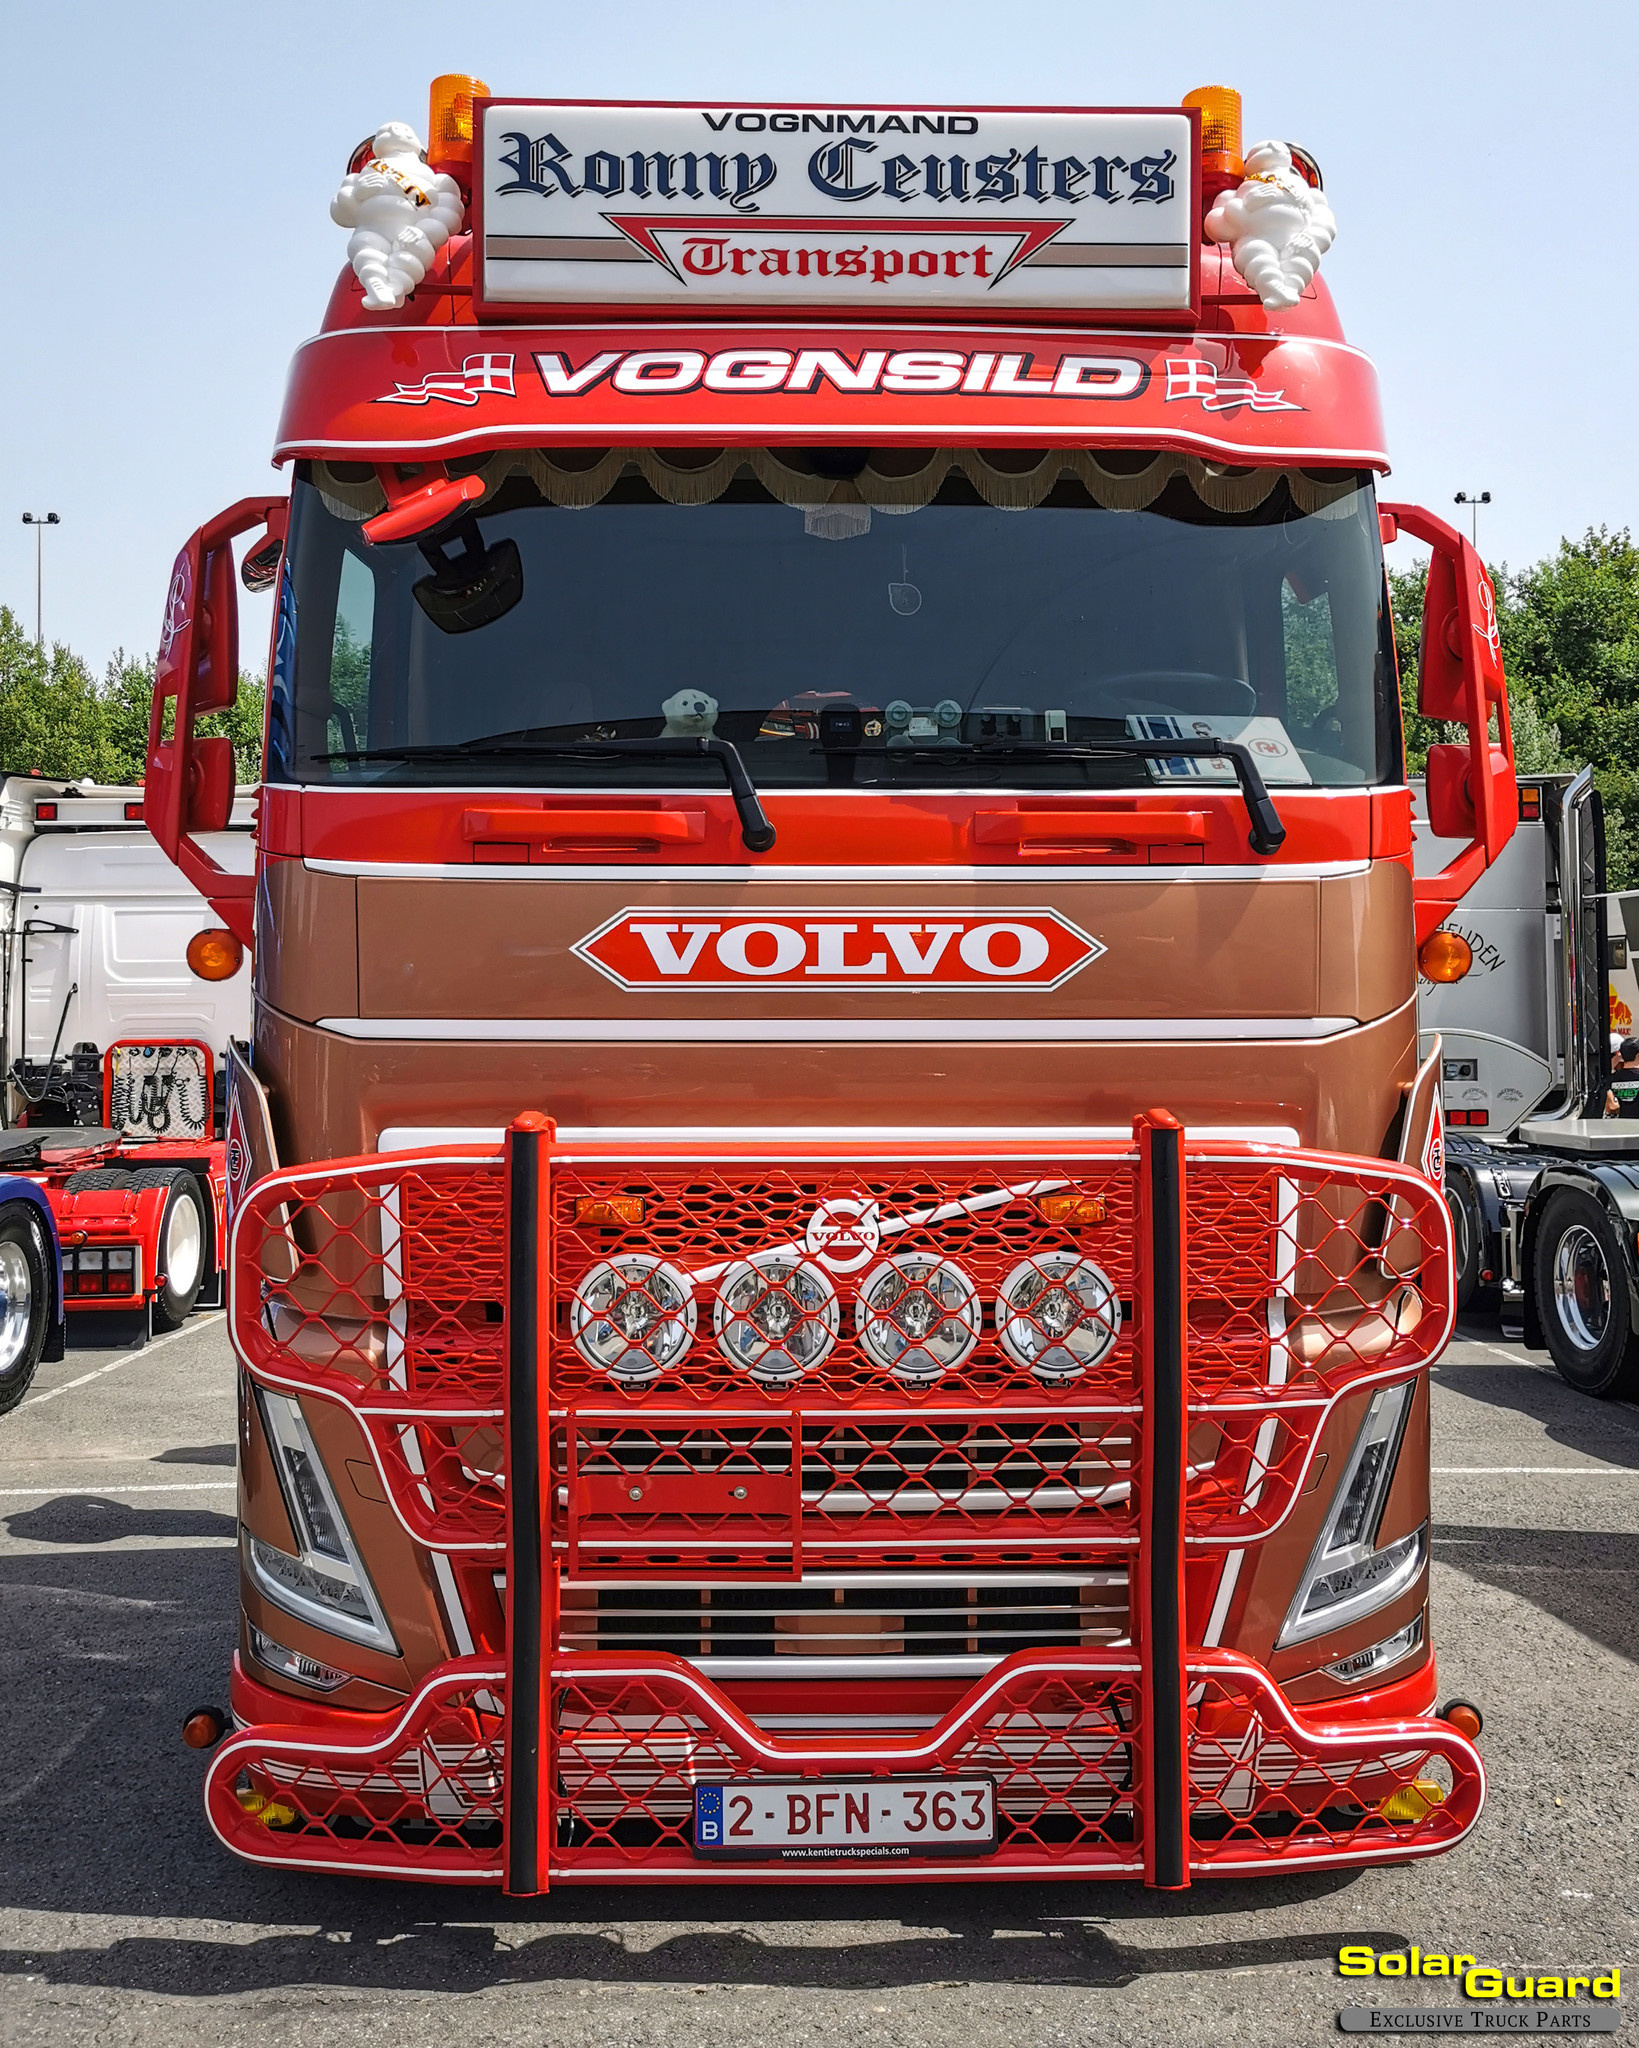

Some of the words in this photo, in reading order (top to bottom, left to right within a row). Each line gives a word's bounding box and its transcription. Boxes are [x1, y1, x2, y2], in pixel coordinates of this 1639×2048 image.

[702, 112, 978, 135] VOGNMAND
[495, 131, 777, 213] Ronny
[808, 137, 1178, 205] Ceusters
[682, 237, 993, 284] Transport
[531, 348, 1151, 400] VOGNSILD
[629, 922, 1049, 976] VOLVO
[809, 1231, 876, 1242] VOLVO
[702, 1821, 719, 1841] B
[781, 1845, 910, 1857] www.kentietruckspecials.com
